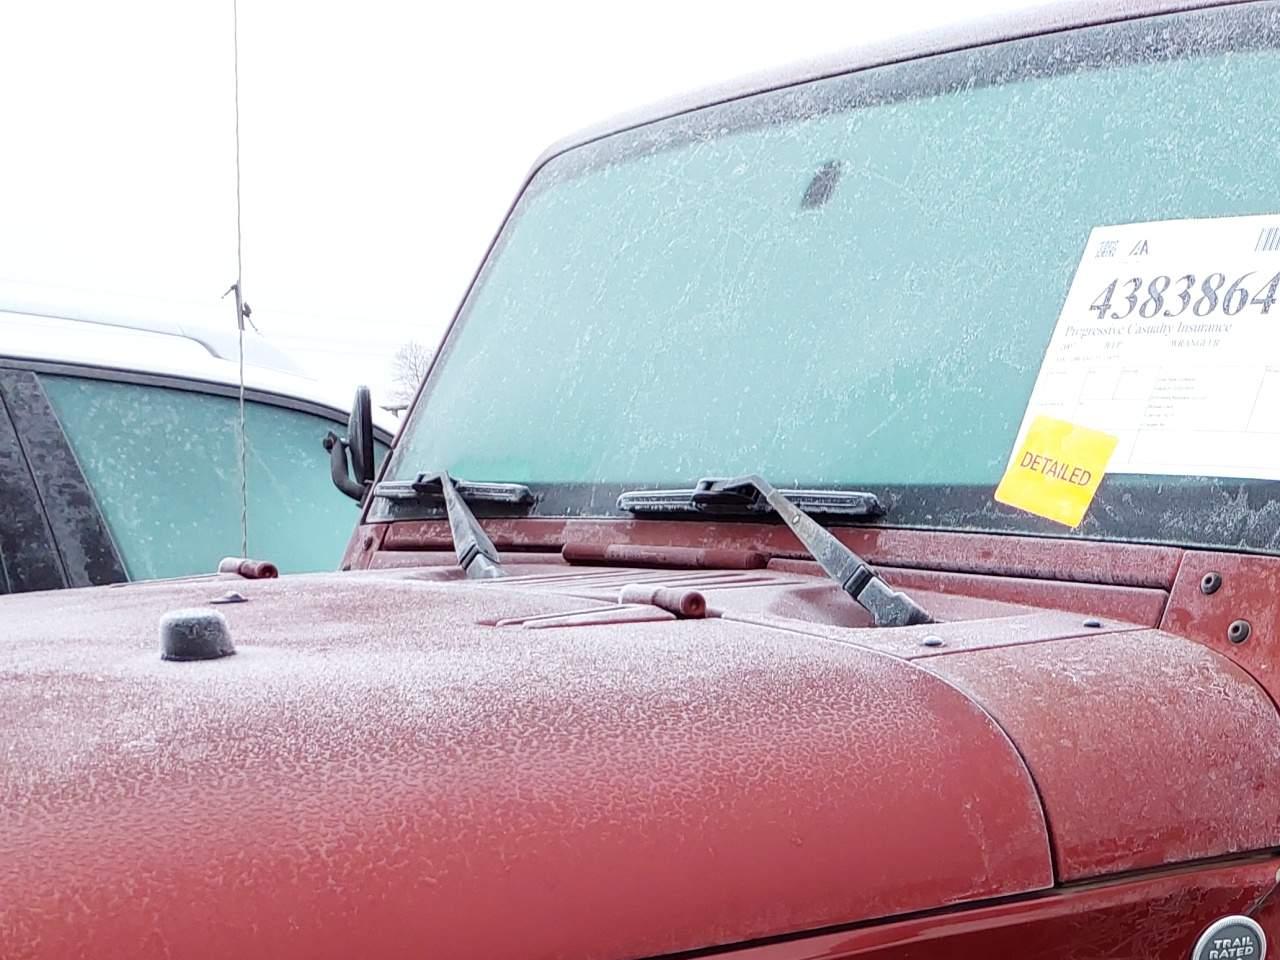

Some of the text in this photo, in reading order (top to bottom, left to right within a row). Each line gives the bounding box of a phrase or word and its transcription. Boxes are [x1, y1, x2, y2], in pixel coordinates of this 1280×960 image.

[1065, 320, 1233, 340] Progressive Casualty Insurance
[1020, 451, 1092, 487] DETAILED
[1213, 936, 1254, 950] TRAIL
[1209, 946, 1254, 960] RATED
